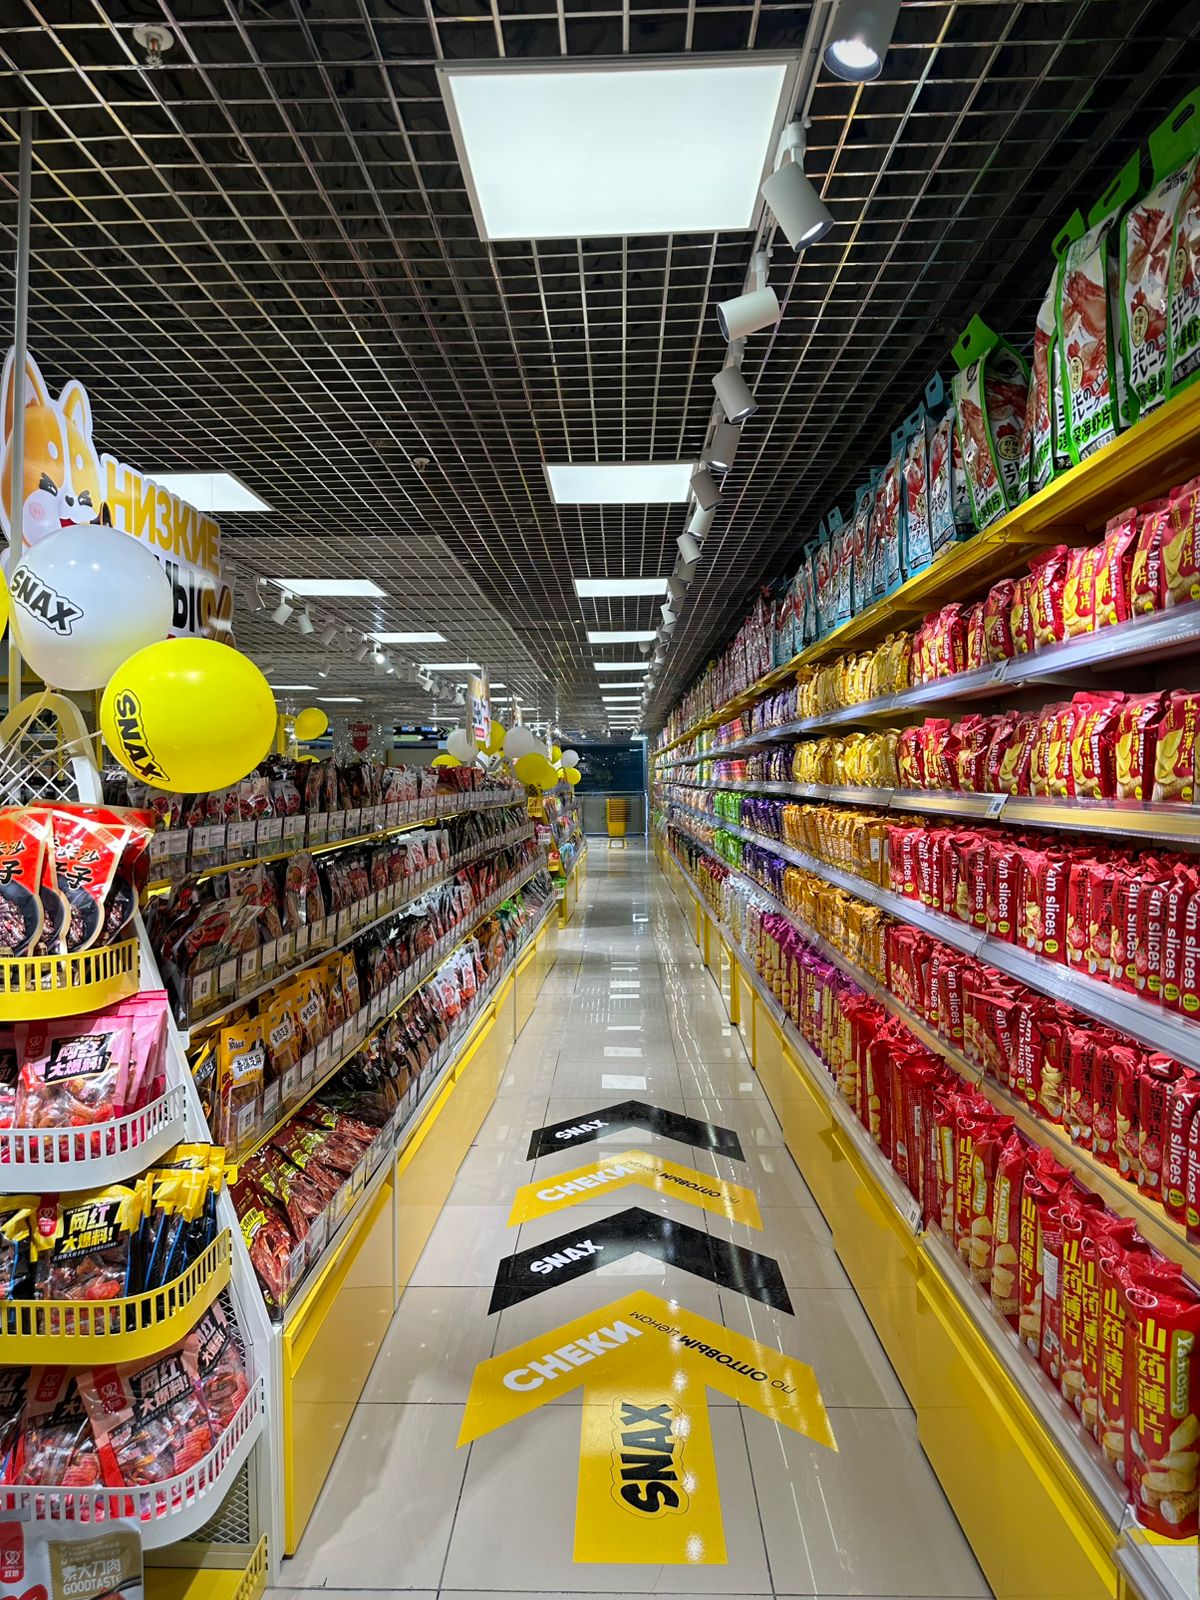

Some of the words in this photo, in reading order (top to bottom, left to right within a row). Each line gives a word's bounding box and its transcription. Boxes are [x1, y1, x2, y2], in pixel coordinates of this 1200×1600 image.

[105, 460, 221, 576] НИЗКИЕ
[11, 570, 77, 632] SNAX
[116, 692, 165, 780] SNAX
[998, 852, 1013, 879] Yam
[1045, 862, 1064, 892] Yam
[975, 875, 987, 910] slices
[998, 882, 1012, 918] slices
[1148, 880, 1170, 917] Yam
[1168, 881, 1185, 923] Yam
[1045, 895, 1060, 936] slices
[1148, 922, 1162, 971] slices
[1165, 927, 1180, 979] slices
[1185, 936, 1200, 989] slices
[949, 992, 962, 1025] slices
[555, 1118, 609, 1141] SNAX
[1171, 1092, 1195, 1129] Yam
[1169, 1134, 1187, 1186] slices
[536, 1162, 637, 1202] СНЕКИ
[60, 1226, 114, 1254] 大爆料!
[69, 1204, 111, 1235] 网红
[530, 1238, 604, 1275] SNAX
[1020, 1196, 1036, 1293] 山药薄片
[1062, 1239, 1081, 1348] 山药薄片
[1082, 1260, 1098, 1374] 山药薄片
[502, 1319, 643, 1393] СНЕКИ
[1102, 1287, 1126, 1407] 山药薄片
[139, 1376, 189, 1418] 大爆料!
[140, 1357, 182, 1396] 网红
[1138, 1317, 1166, 1445] 山药薄片
[620, 1401, 680, 1514] SNAX
[63, 1573, 123, 1595] GOODTASTE
